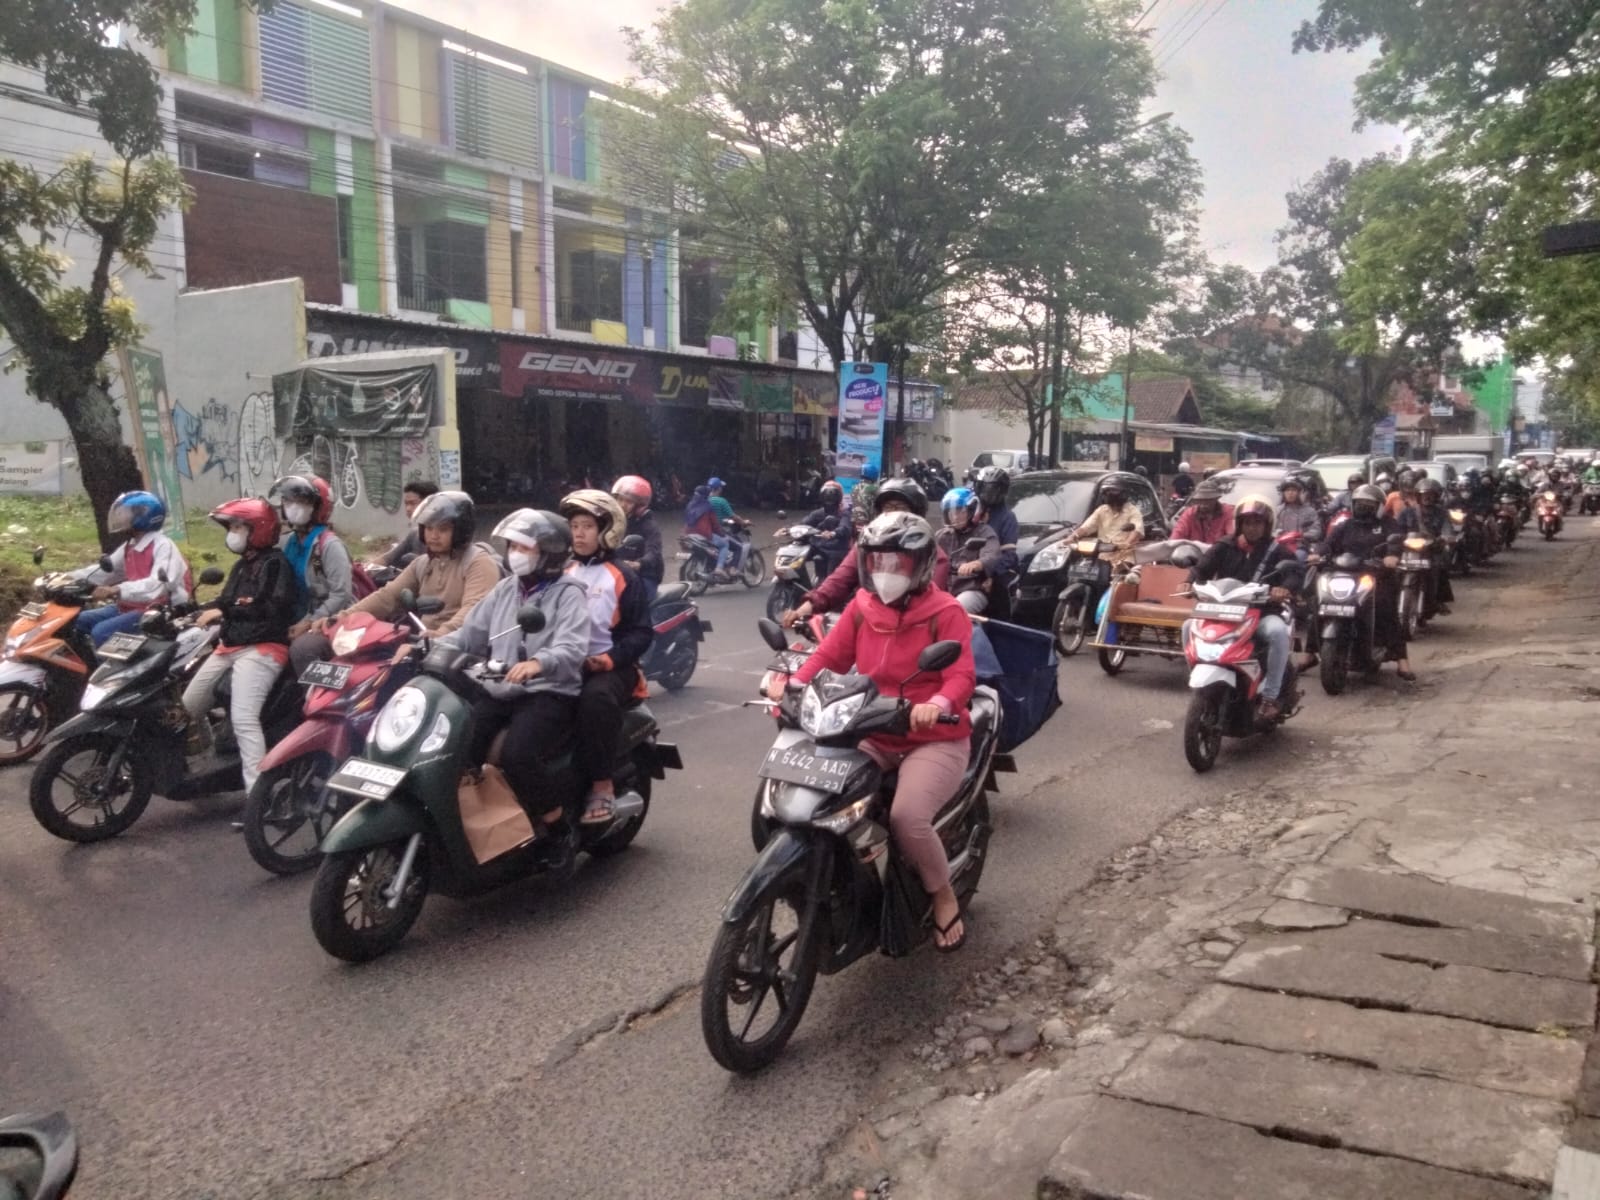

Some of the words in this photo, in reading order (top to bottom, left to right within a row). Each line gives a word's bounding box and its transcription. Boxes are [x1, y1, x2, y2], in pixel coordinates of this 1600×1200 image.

[518, 352, 637, 379] GENIO
[768, 750, 778, 762] N
[781, 751, 815, 770] 6442
[819, 759, 848, 777] AAC
